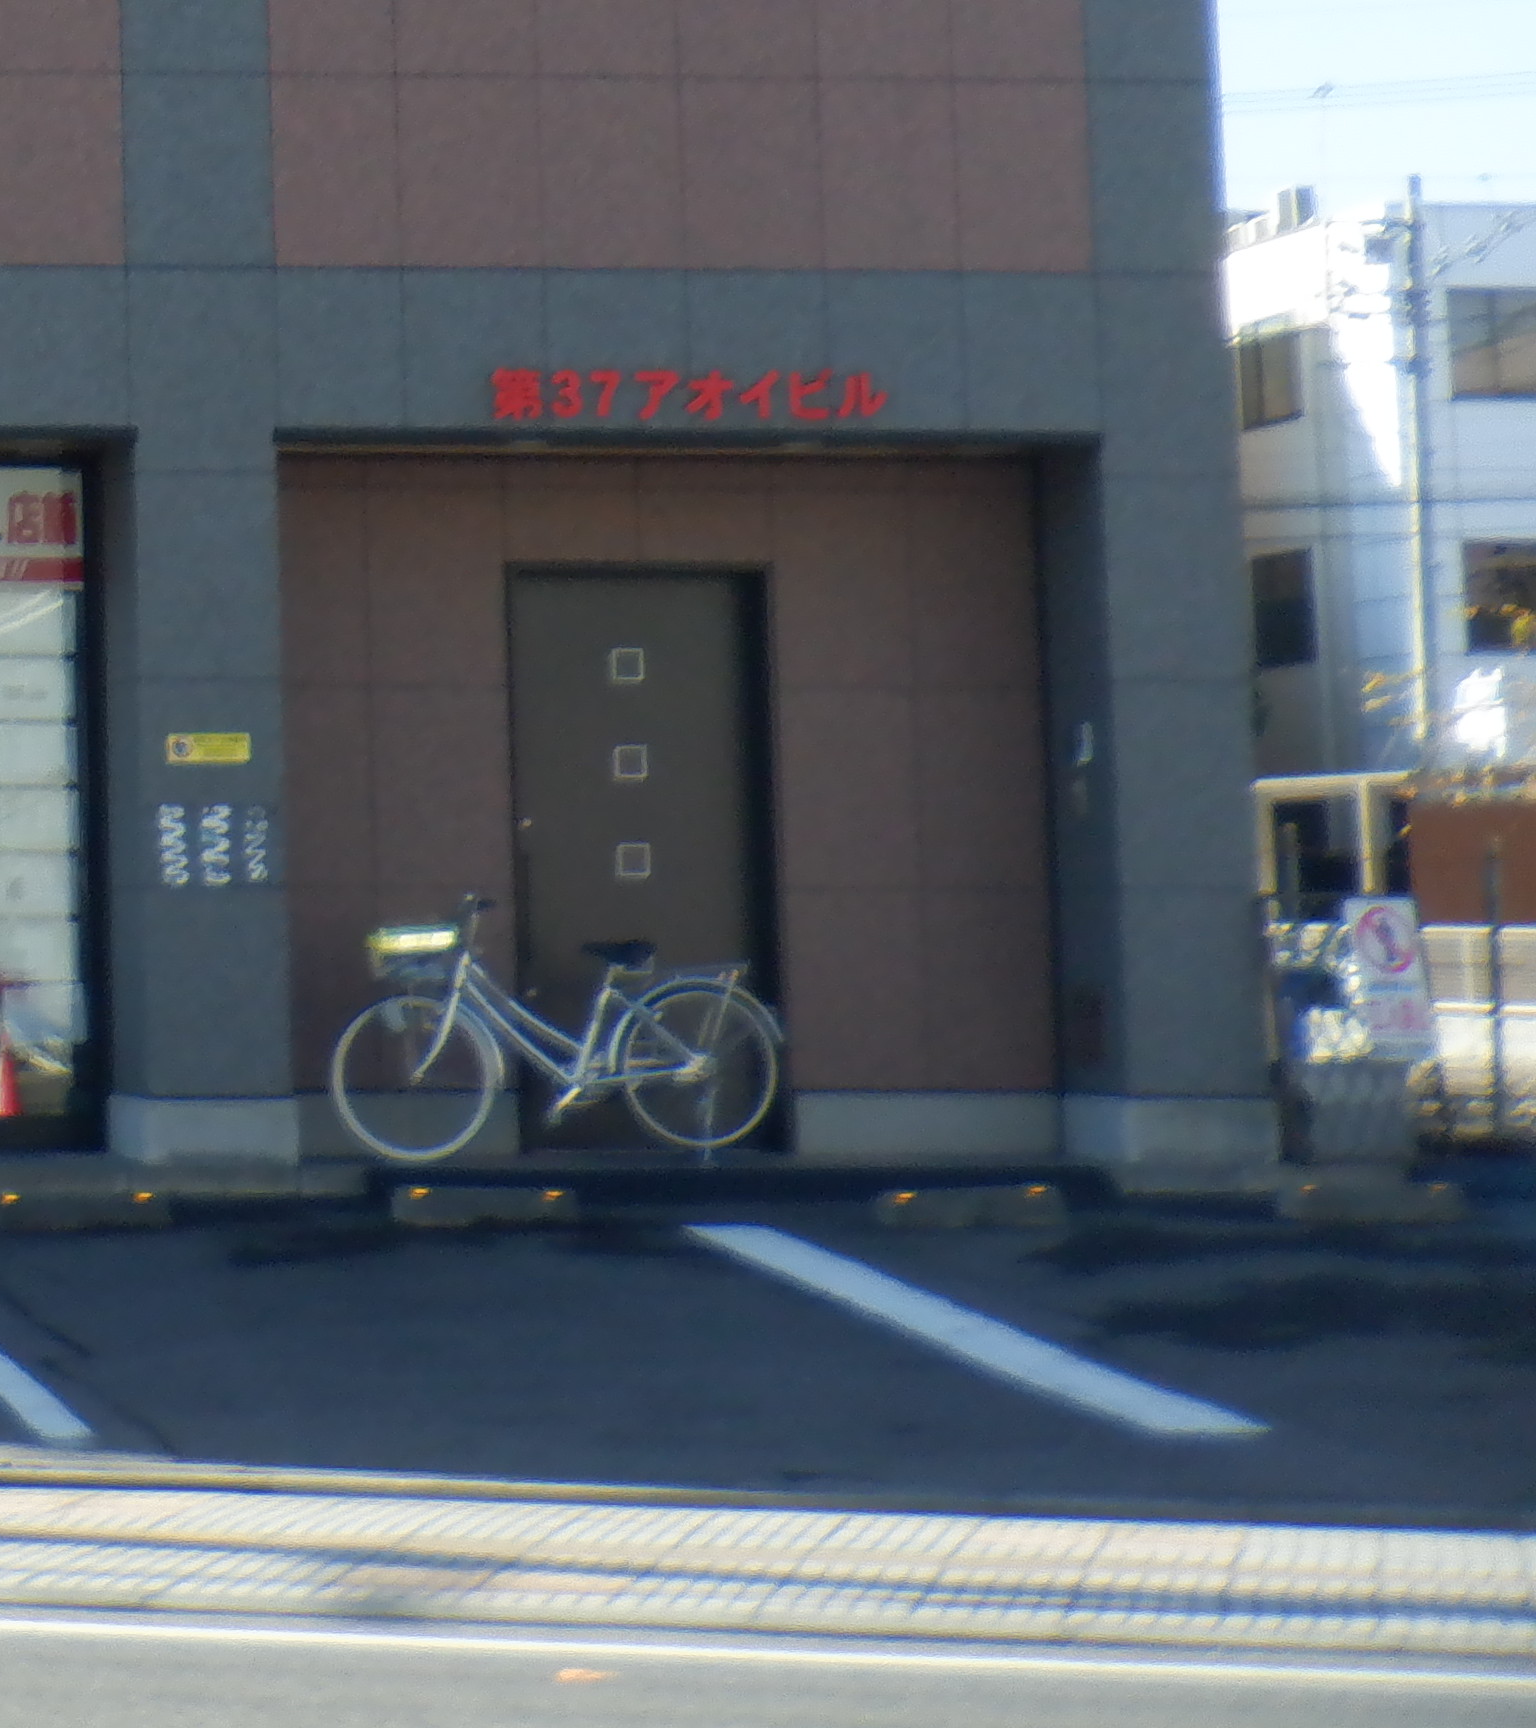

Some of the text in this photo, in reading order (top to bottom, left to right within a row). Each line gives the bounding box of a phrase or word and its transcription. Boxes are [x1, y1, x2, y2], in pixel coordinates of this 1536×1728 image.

[491, 367, 888, 421] 第37アオイビル
